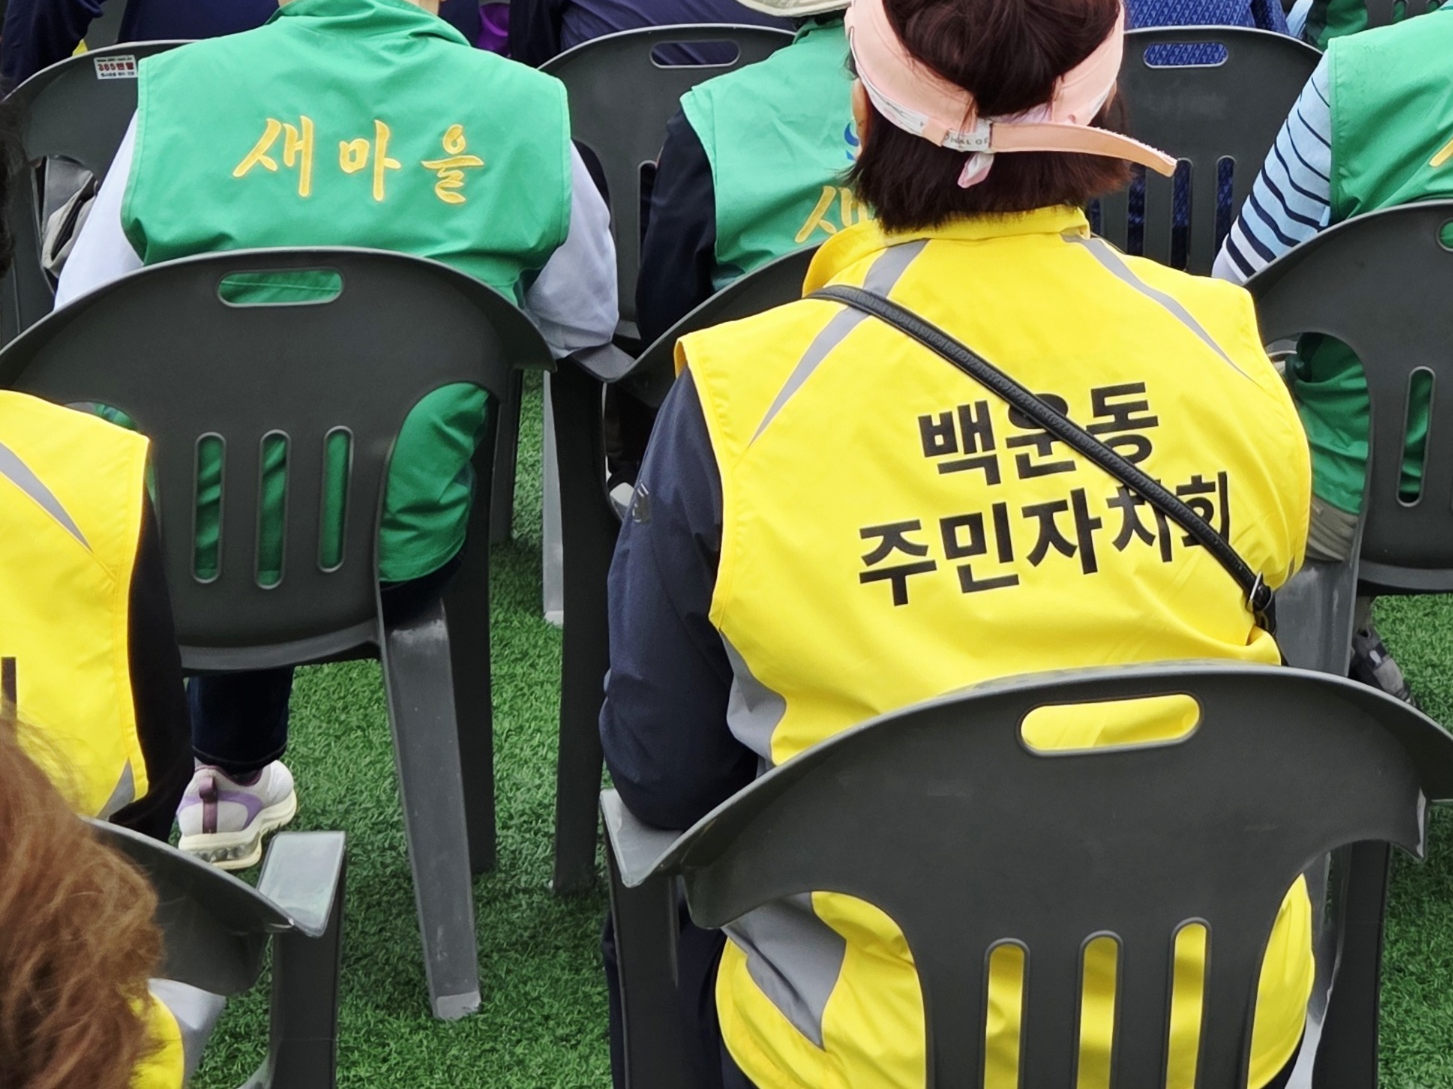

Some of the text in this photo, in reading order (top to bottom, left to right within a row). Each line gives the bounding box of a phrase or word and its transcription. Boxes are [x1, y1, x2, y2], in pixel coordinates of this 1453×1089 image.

[231, 114, 485, 205] 새마을
[917, 381, 1160, 488] 백운동
[858, 470, 1233, 608] 주민자치회
